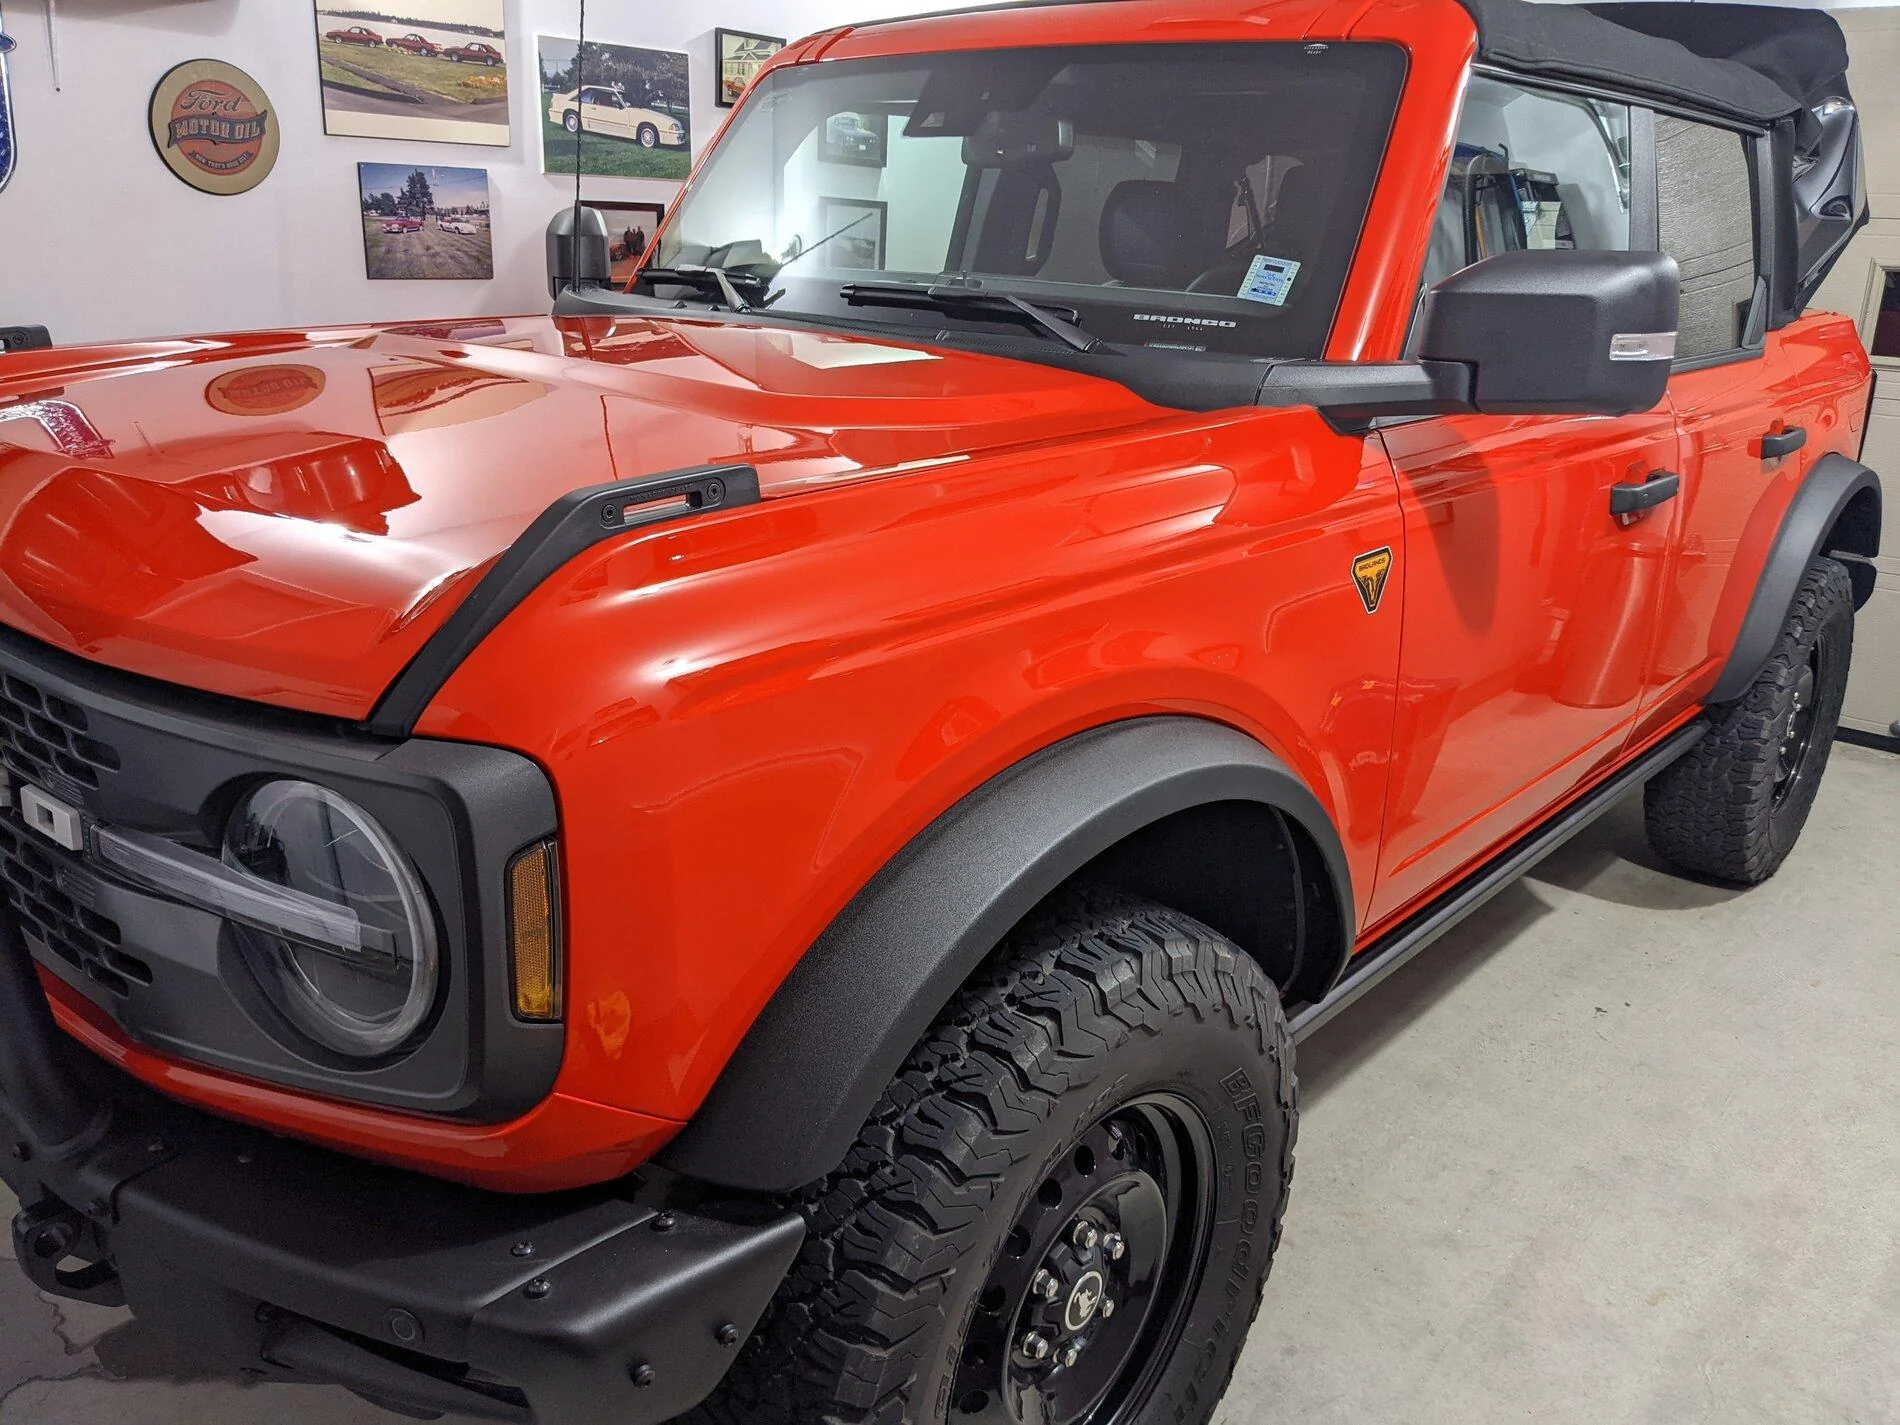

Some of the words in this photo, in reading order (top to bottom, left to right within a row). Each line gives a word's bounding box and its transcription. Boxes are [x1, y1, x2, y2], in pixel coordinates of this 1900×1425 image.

[180, 89, 242, 111] Ford
[176, 118, 230, 139] MOTOR
[234, 120, 260, 139] OIL
[1133, 313, 1237, 328] BRONCO
